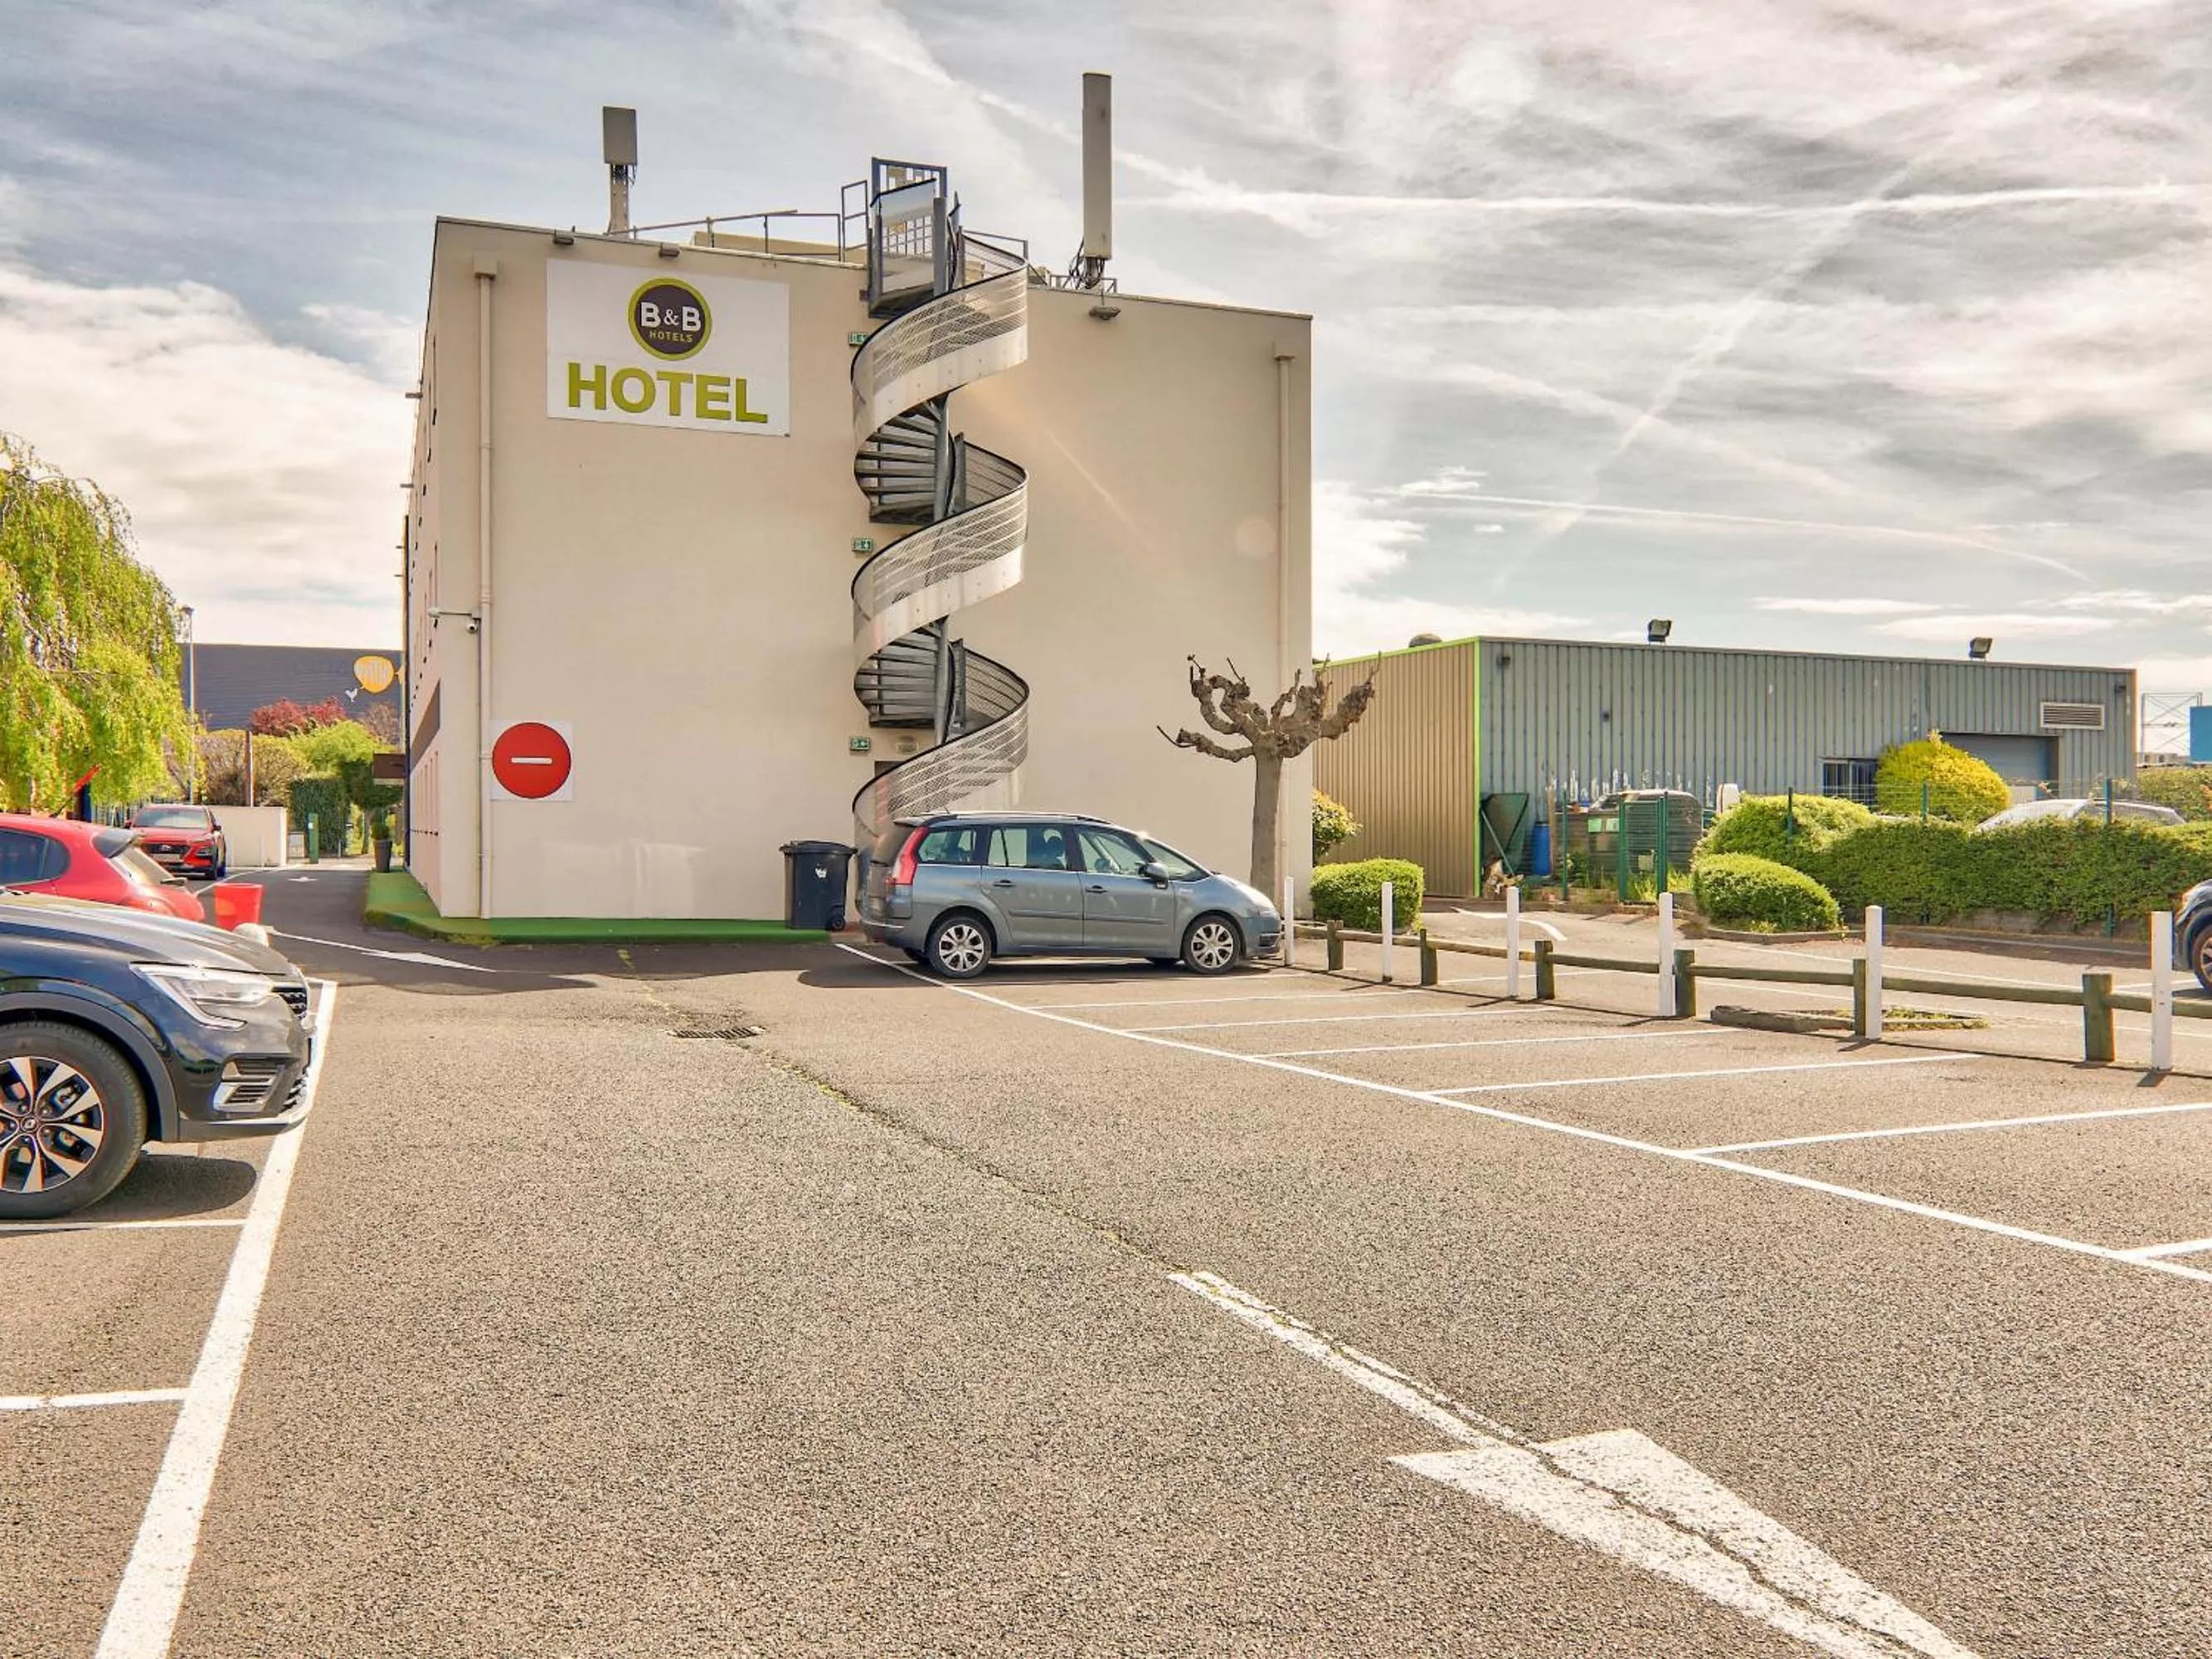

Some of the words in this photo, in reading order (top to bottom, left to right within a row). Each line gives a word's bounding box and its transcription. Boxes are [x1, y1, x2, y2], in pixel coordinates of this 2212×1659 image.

[640, 302, 702, 332] B&B
[649, 330, 693, 343] HOTELS
[568, 362, 768, 423] HOTEL
